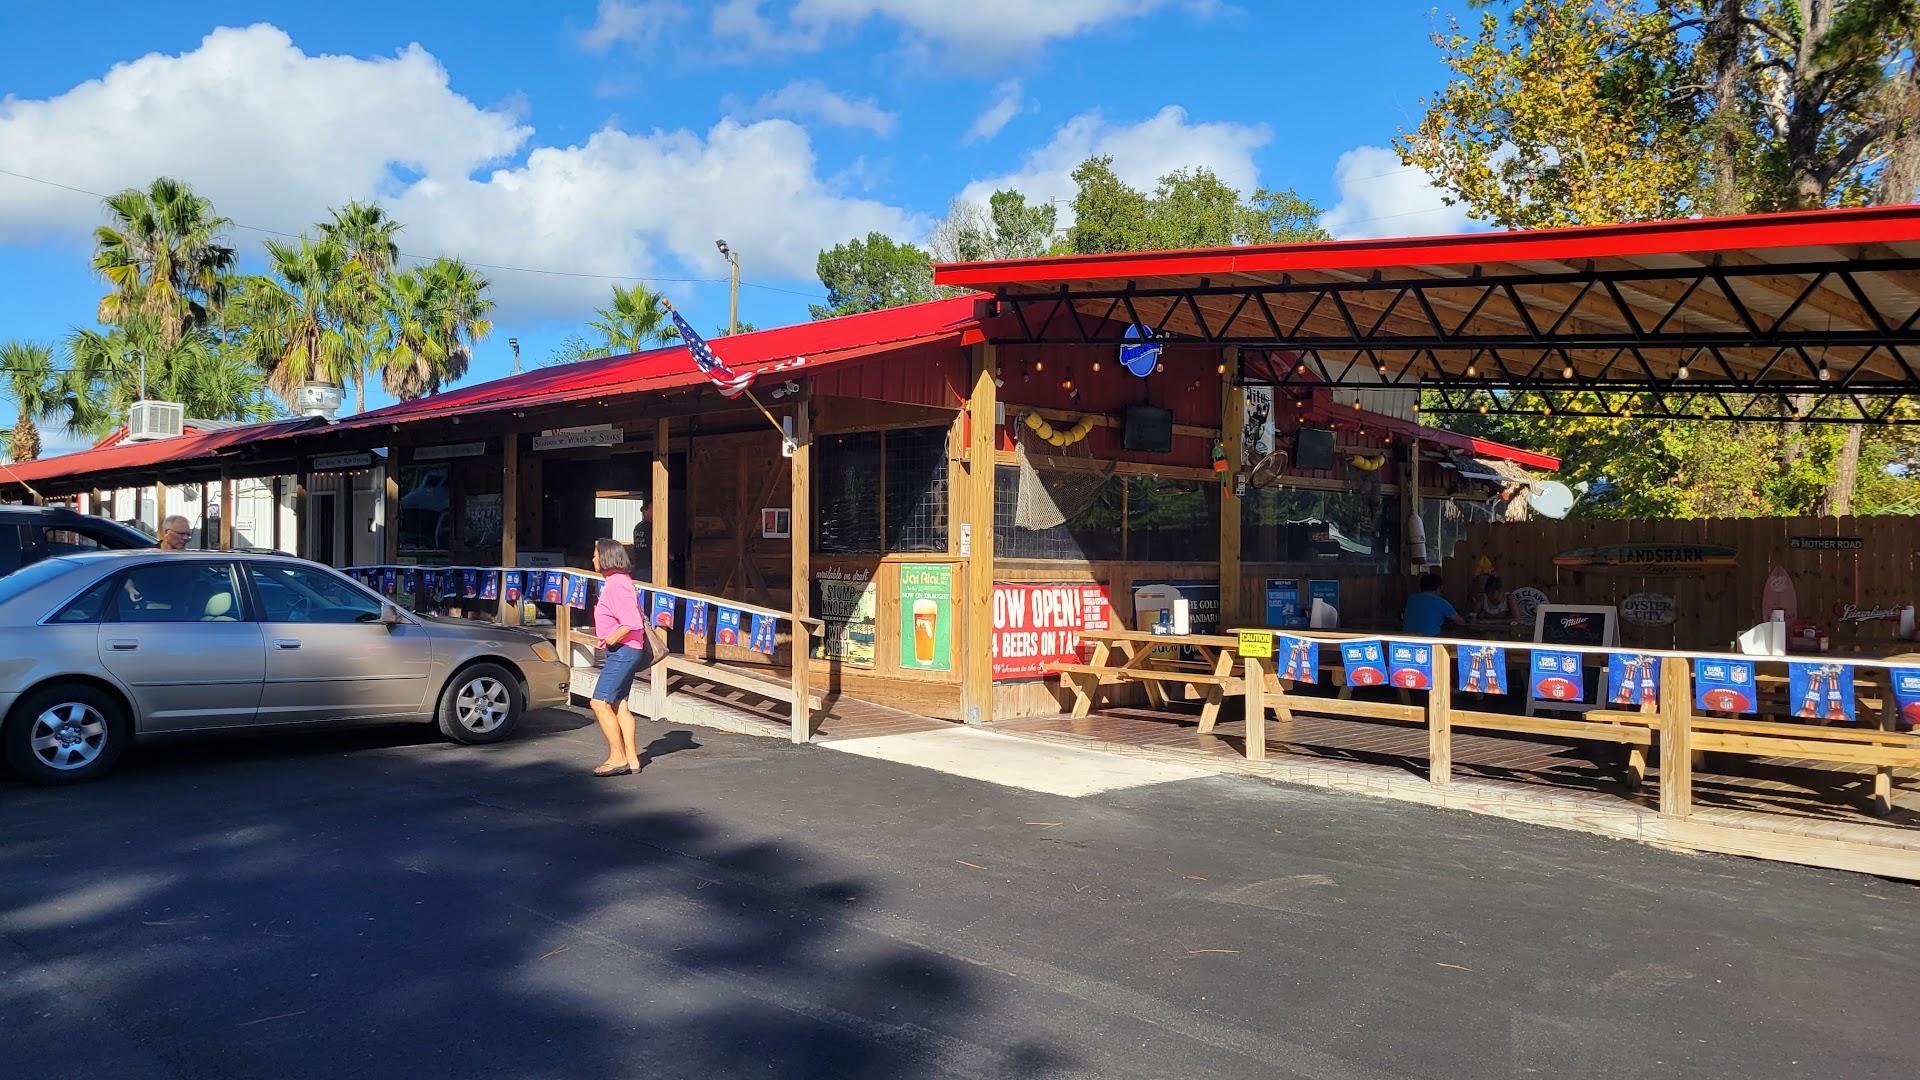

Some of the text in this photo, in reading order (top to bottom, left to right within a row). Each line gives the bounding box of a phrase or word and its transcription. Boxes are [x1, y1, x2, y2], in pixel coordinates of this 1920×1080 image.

[1801, 539, 1836, 549] MOTHER
[1837, 540, 1862, 549] ROAD
[1619, 548, 1704, 563] LANDSHARK
[902, 570, 941, 585] Jai Alai
[827, 584, 856, 601] STUMP
[1522, 590, 1545, 604] CLAW
[822, 600, 861, 617] KNOCKER
[993, 588, 1081, 629] OW OPEN!
[1189, 599, 1219, 610] HE GOLD
[1624, 600, 1673, 611] OYSTER
[1190, 613, 1218, 623] ANDARD
[1560, 616, 1590, 628] Miller
[1635, 610, 1665, 621] CITY
[827, 624, 850, 641] WILD
[1242, 633, 1270, 642] CAUTION
[826, 641, 850, 656] NIGHT
[1002, 631, 1038, 658] BEERS
[1041, 631, 1056, 656] ON
[993, 662, 1020, 673] Welcome
[1021, 664, 1028, 672] to
[1028, 663, 1036, 672] the
